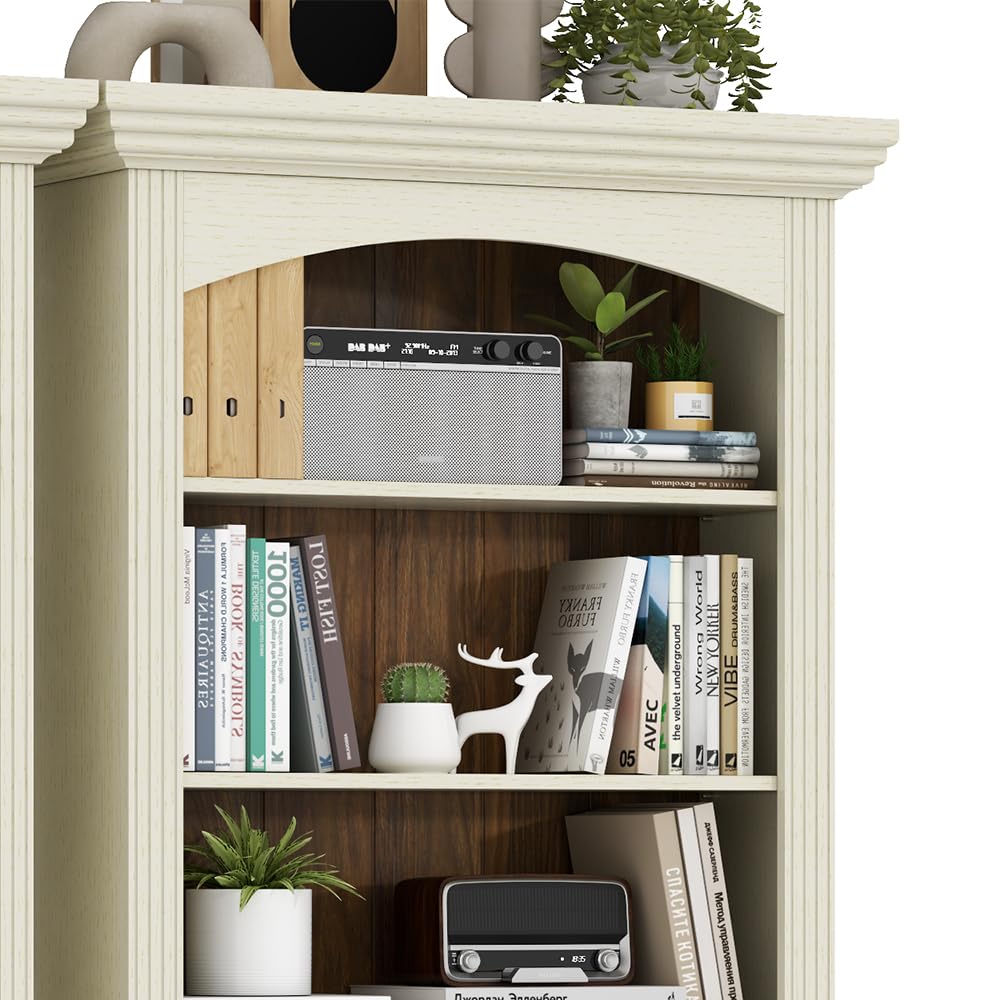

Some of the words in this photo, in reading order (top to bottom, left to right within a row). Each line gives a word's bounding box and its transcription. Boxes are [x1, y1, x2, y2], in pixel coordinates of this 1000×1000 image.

[651, 480, 696, 488] Revolution
[695, 570, 703, 625] World
[672, 624, 683, 689] underground
[707, 603, 719, 661] YORKER
[695, 632, 704, 695] Wrong
[707, 663, 719, 697] NEW
[724, 655, 738, 707] VIBE
[643, 699, 659, 751] AVEC
[672, 692, 681, 721] velvet
[672, 724, 681, 741] the
[620, 750, 635, 767] 05
[666, 867, 690, 938] СПАСИТЕ
[714, 892, 726, 923] Метод
[718, 923, 735, 985] управления
